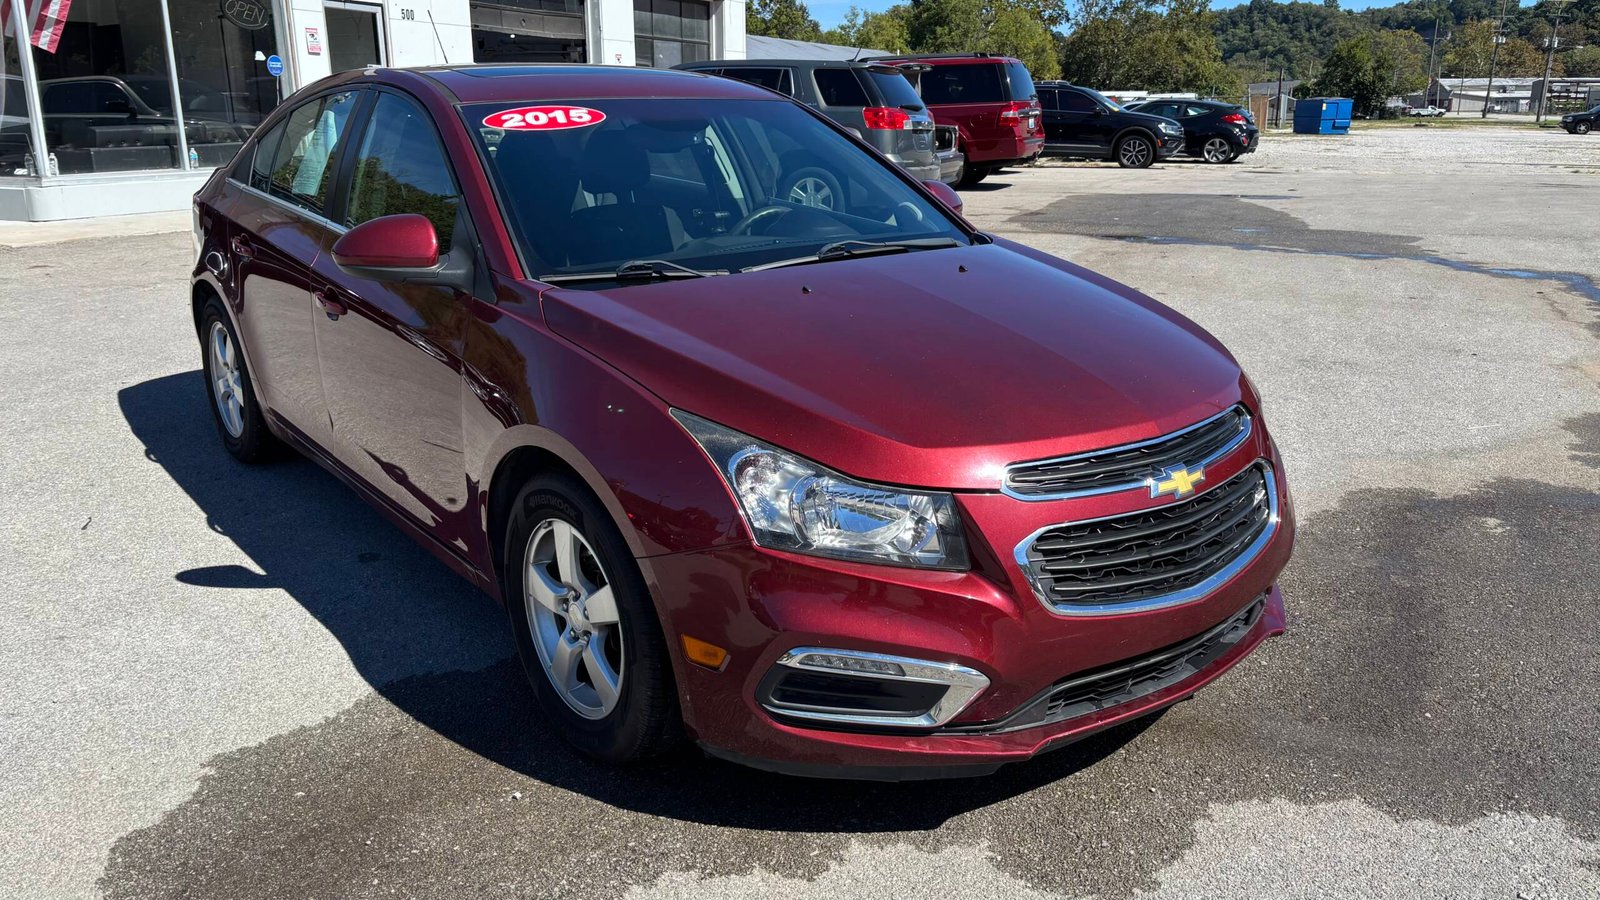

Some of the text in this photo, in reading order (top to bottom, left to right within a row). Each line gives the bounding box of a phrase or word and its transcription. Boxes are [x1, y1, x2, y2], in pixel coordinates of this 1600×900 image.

[225, 0, 265, 24] OPEN
[401, 9, 414, 20] 500
[501, 109, 591, 128] 2015
